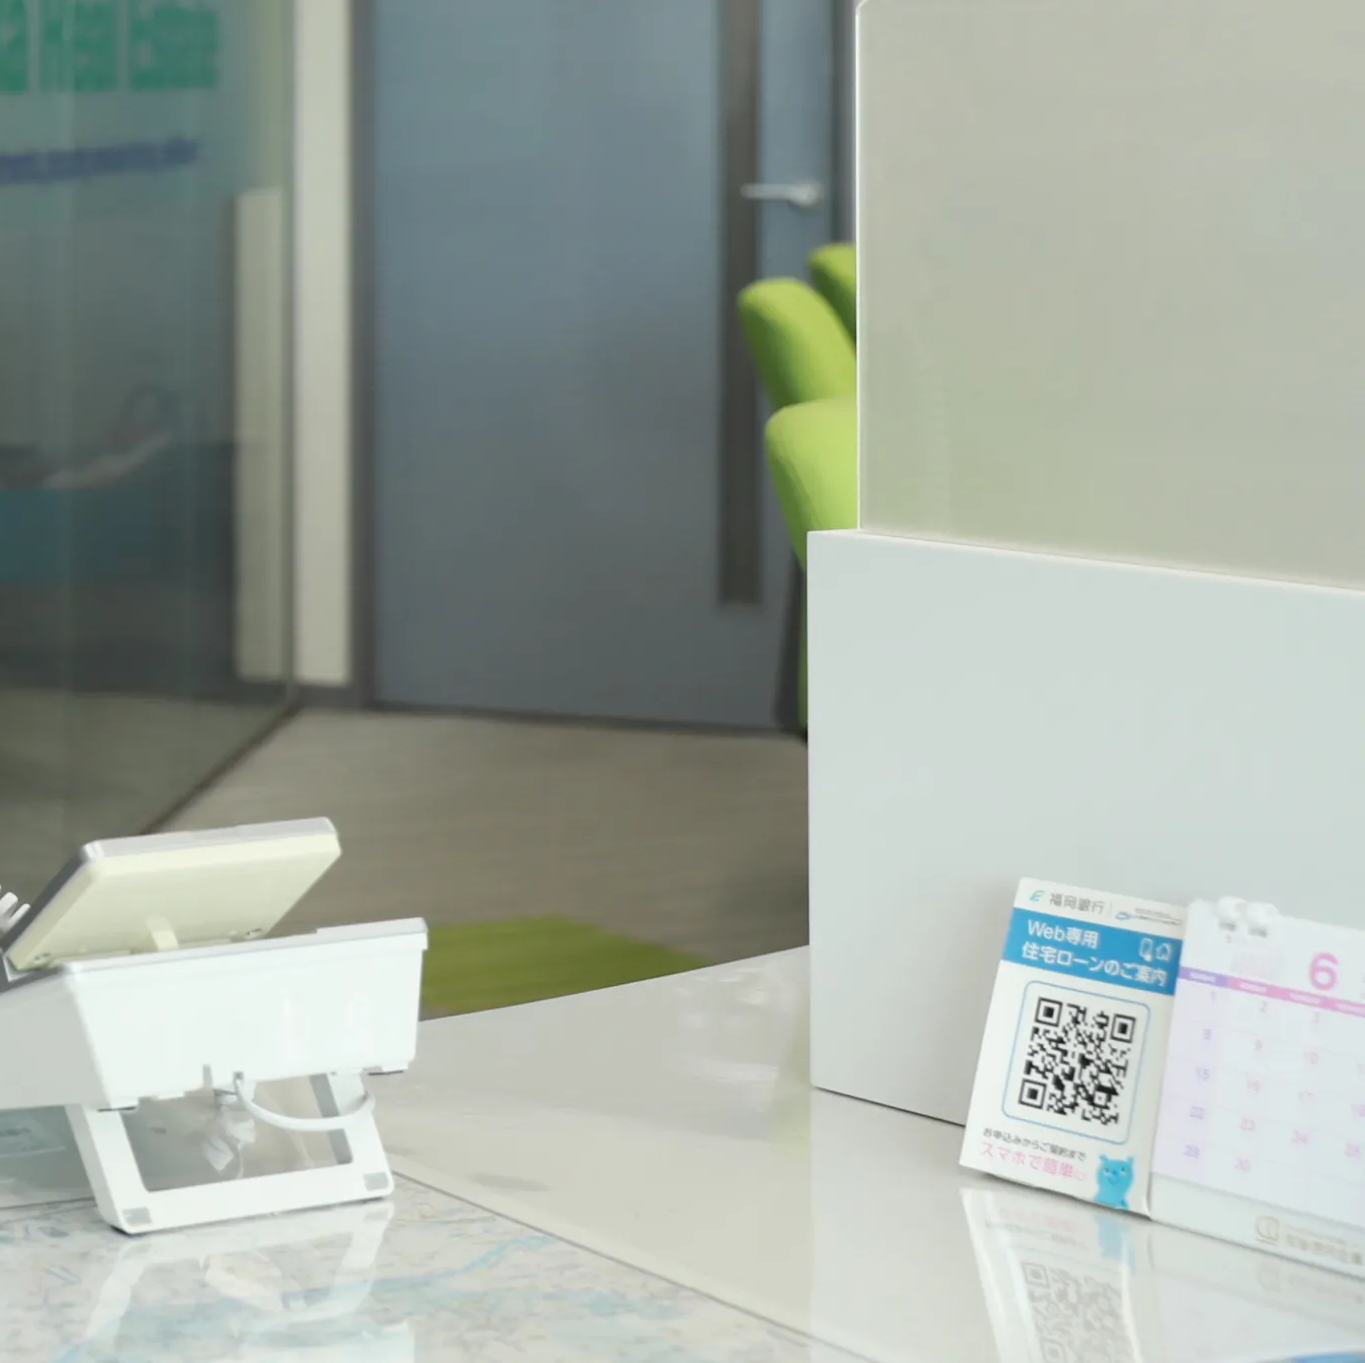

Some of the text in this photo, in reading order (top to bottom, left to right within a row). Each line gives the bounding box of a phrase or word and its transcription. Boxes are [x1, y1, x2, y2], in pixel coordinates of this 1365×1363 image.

[1049, 892, 1105, 915] 福岡銀行
[1027, 919, 1100, 950] Web専用
[1021, 941, 1168, 987] 住宅ローンのご案内
[1309, 952, 1339, 991] 6
